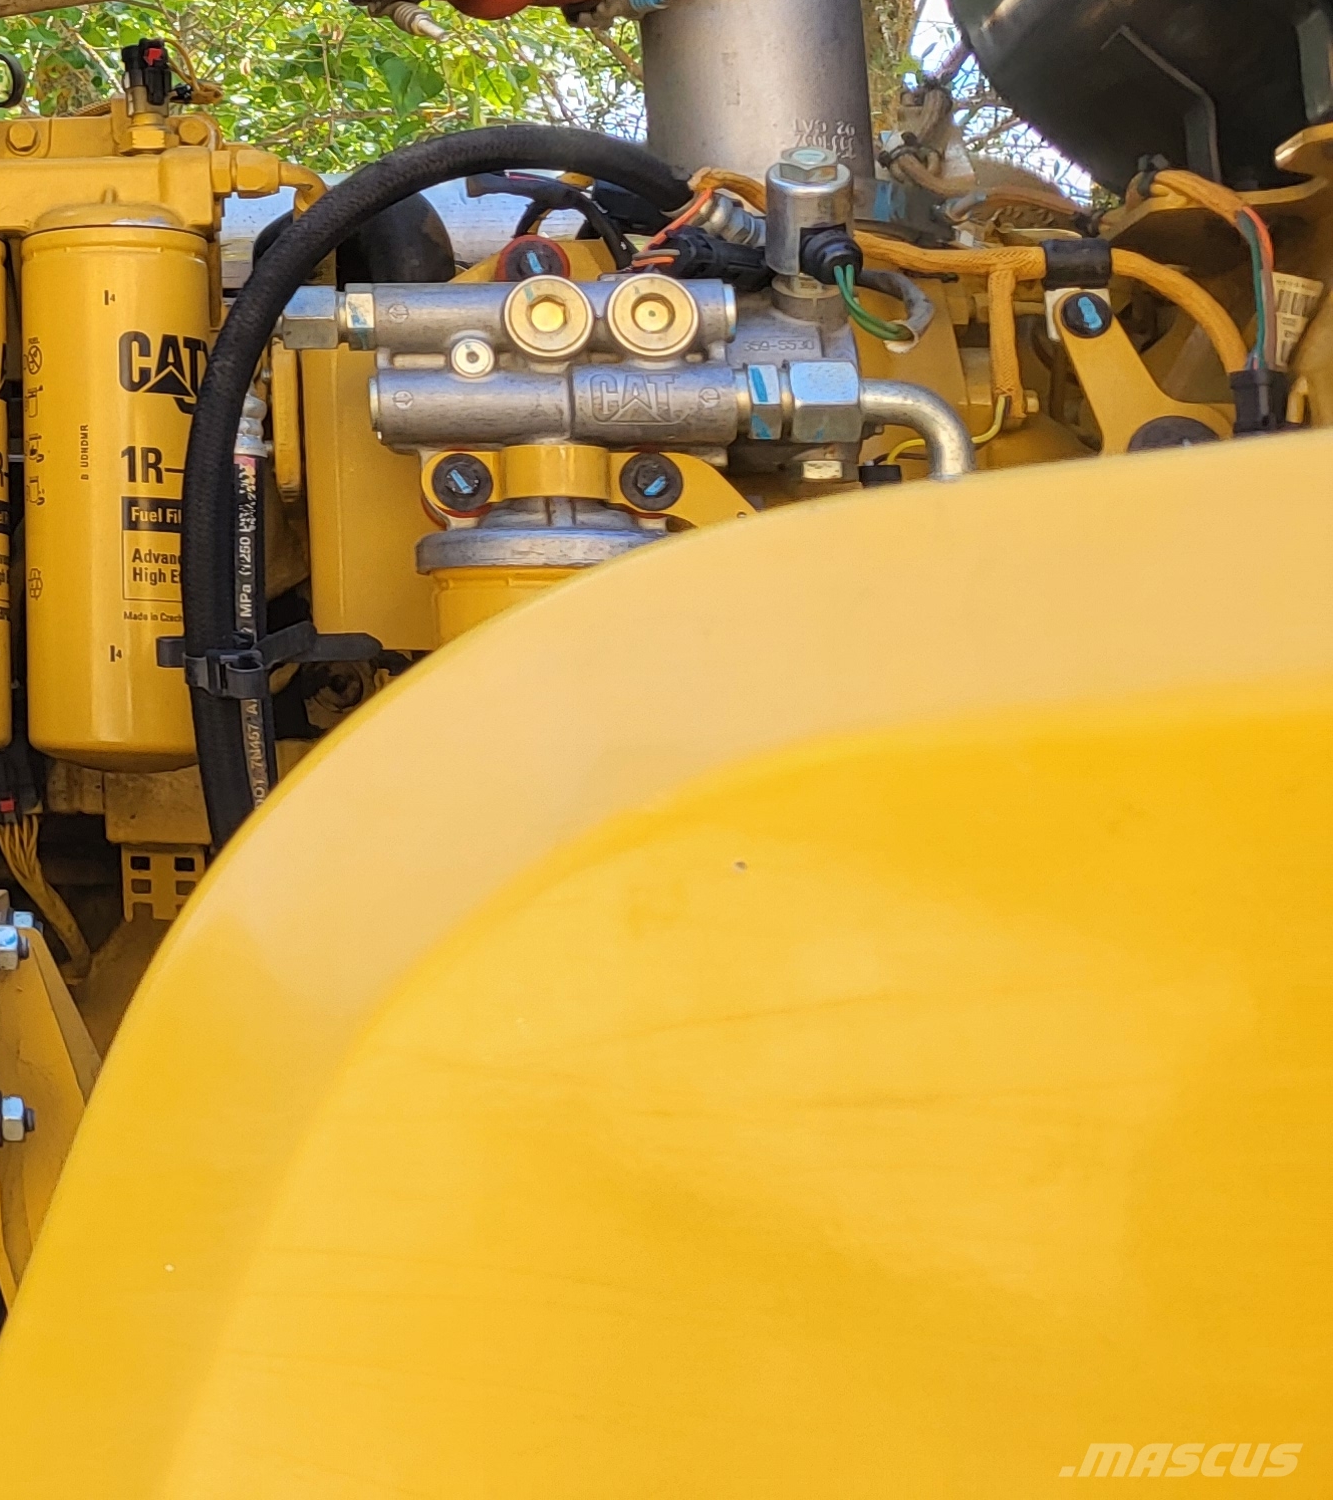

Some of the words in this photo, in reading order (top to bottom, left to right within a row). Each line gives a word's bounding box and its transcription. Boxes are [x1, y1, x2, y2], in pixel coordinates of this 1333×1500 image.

[118, 330, 201, 398] CAT
[589, 372, 679, 425] CAT
[130, 506, 163, 522] Fuel
[132, 567, 166, 586] High
[239, 583, 253, 618] MPa
[123, 610, 148, 621] Made
[150, 611, 159, 621] in
